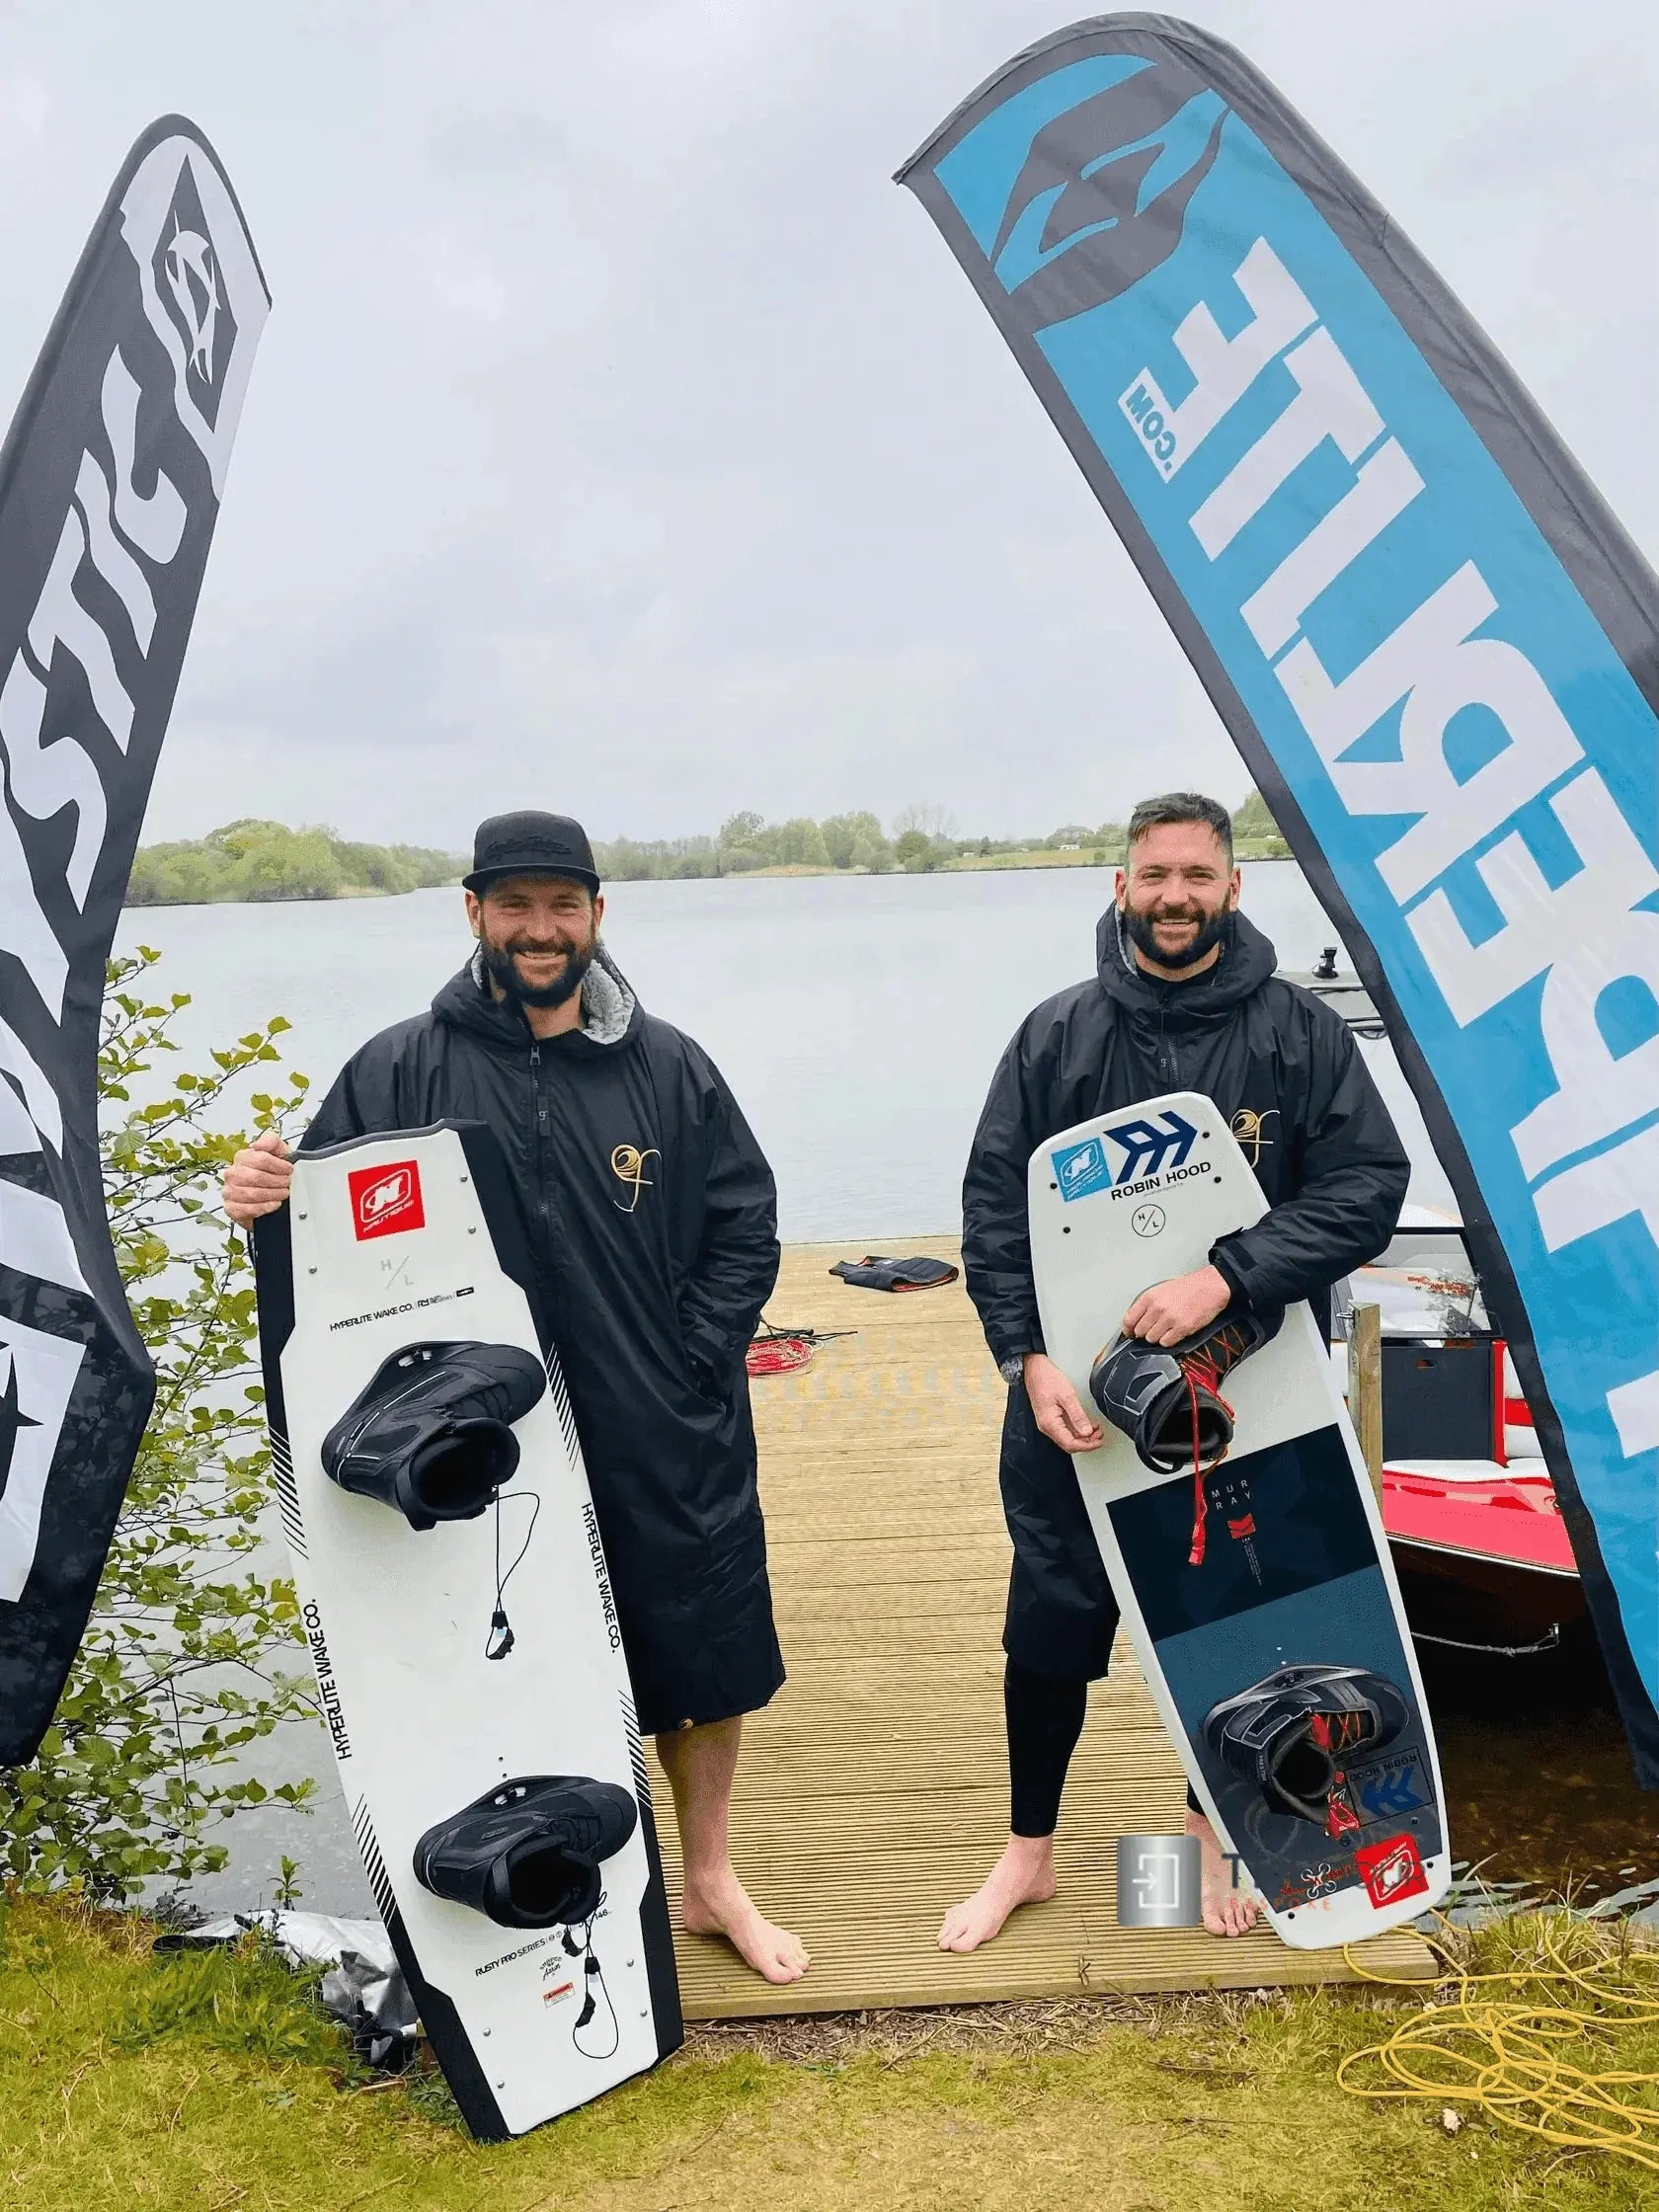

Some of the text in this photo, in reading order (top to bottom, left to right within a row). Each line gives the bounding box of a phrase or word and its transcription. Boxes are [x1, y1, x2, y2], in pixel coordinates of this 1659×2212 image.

[1111, 1177, 1160, 1201] ROBIN
[1166, 1161, 1212, 1187] HOOD
[330, 1314, 372, 1331] HYPERLITE
[373, 1306, 398, 1319] WAKE
[582, 1502, 621, 1654] HYPERLITE WAKE CO.
[303, 1598, 353, 1761] HYPERLITE WAKE CO.
[1349, 1755, 1418, 1783] ROBIN HOOD
[475, 1961, 500, 1977] RUSTY
[500, 1951, 517, 1967] PRO
[517, 1938, 546, 1956] SERIES
